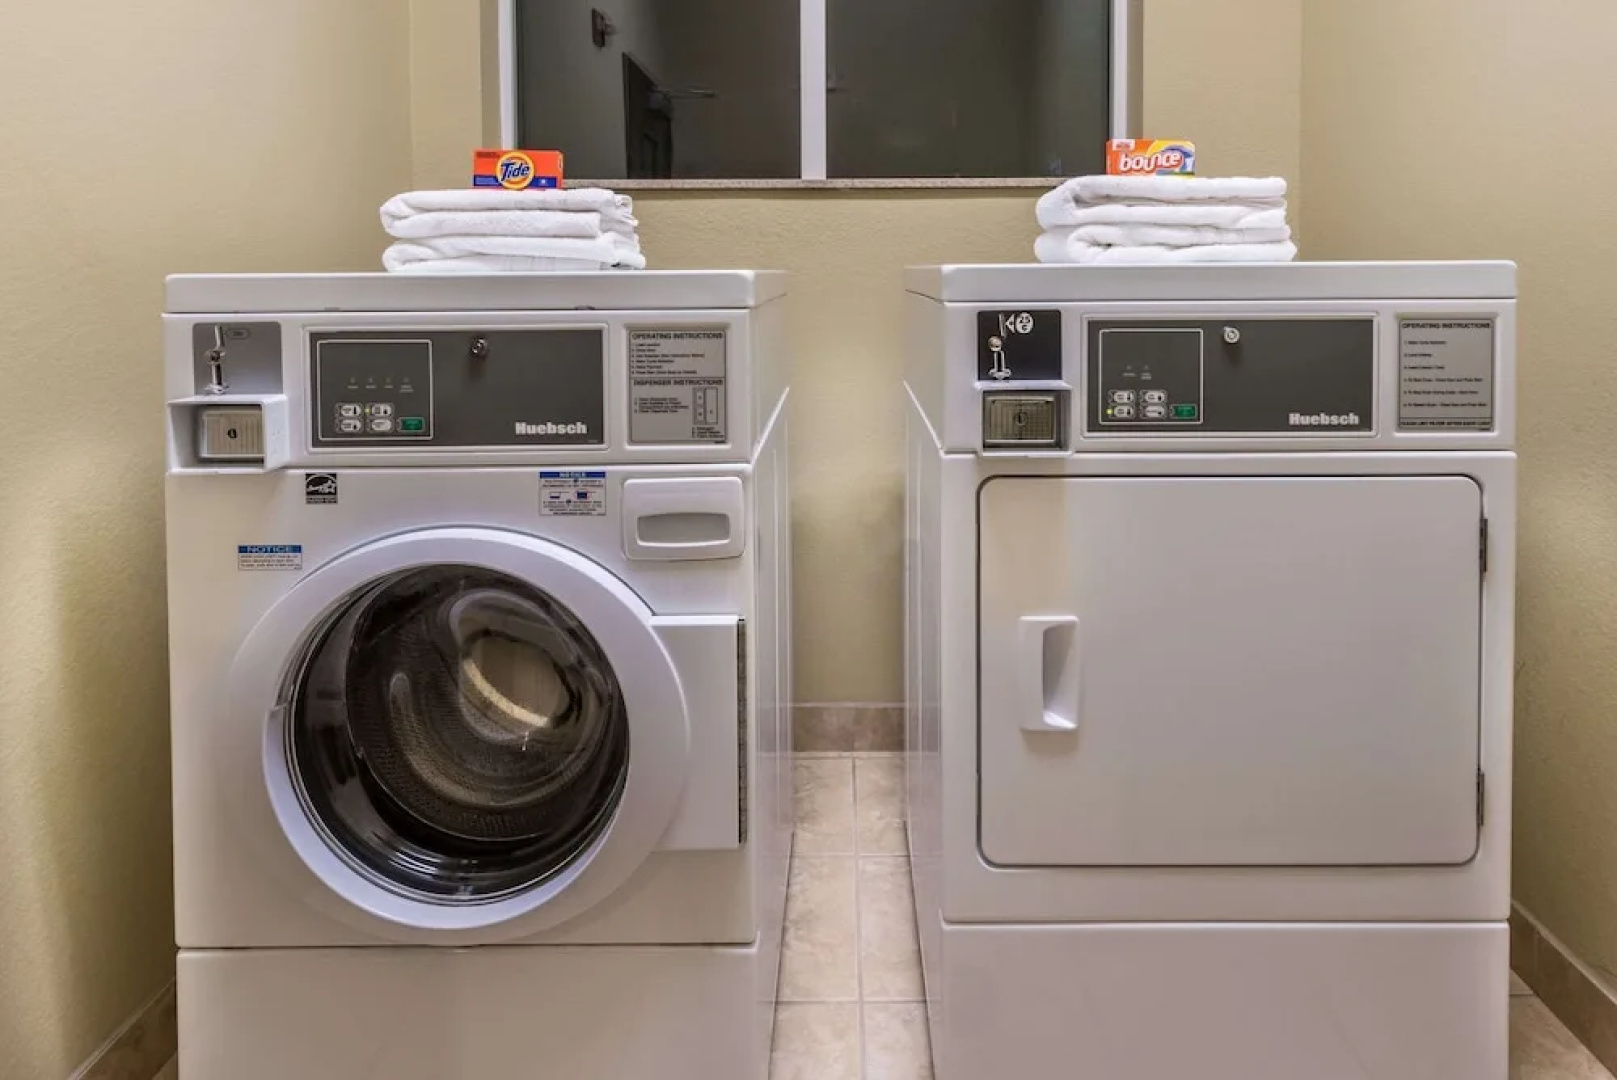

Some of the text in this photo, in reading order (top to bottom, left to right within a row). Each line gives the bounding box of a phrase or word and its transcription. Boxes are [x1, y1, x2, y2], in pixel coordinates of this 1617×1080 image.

[1119, 152, 1180, 171] bounce
[501, 161, 530, 181] Tide
[1288, 412, 1359, 426] Huebsch
[515, 421, 588, 435] Huebsch
